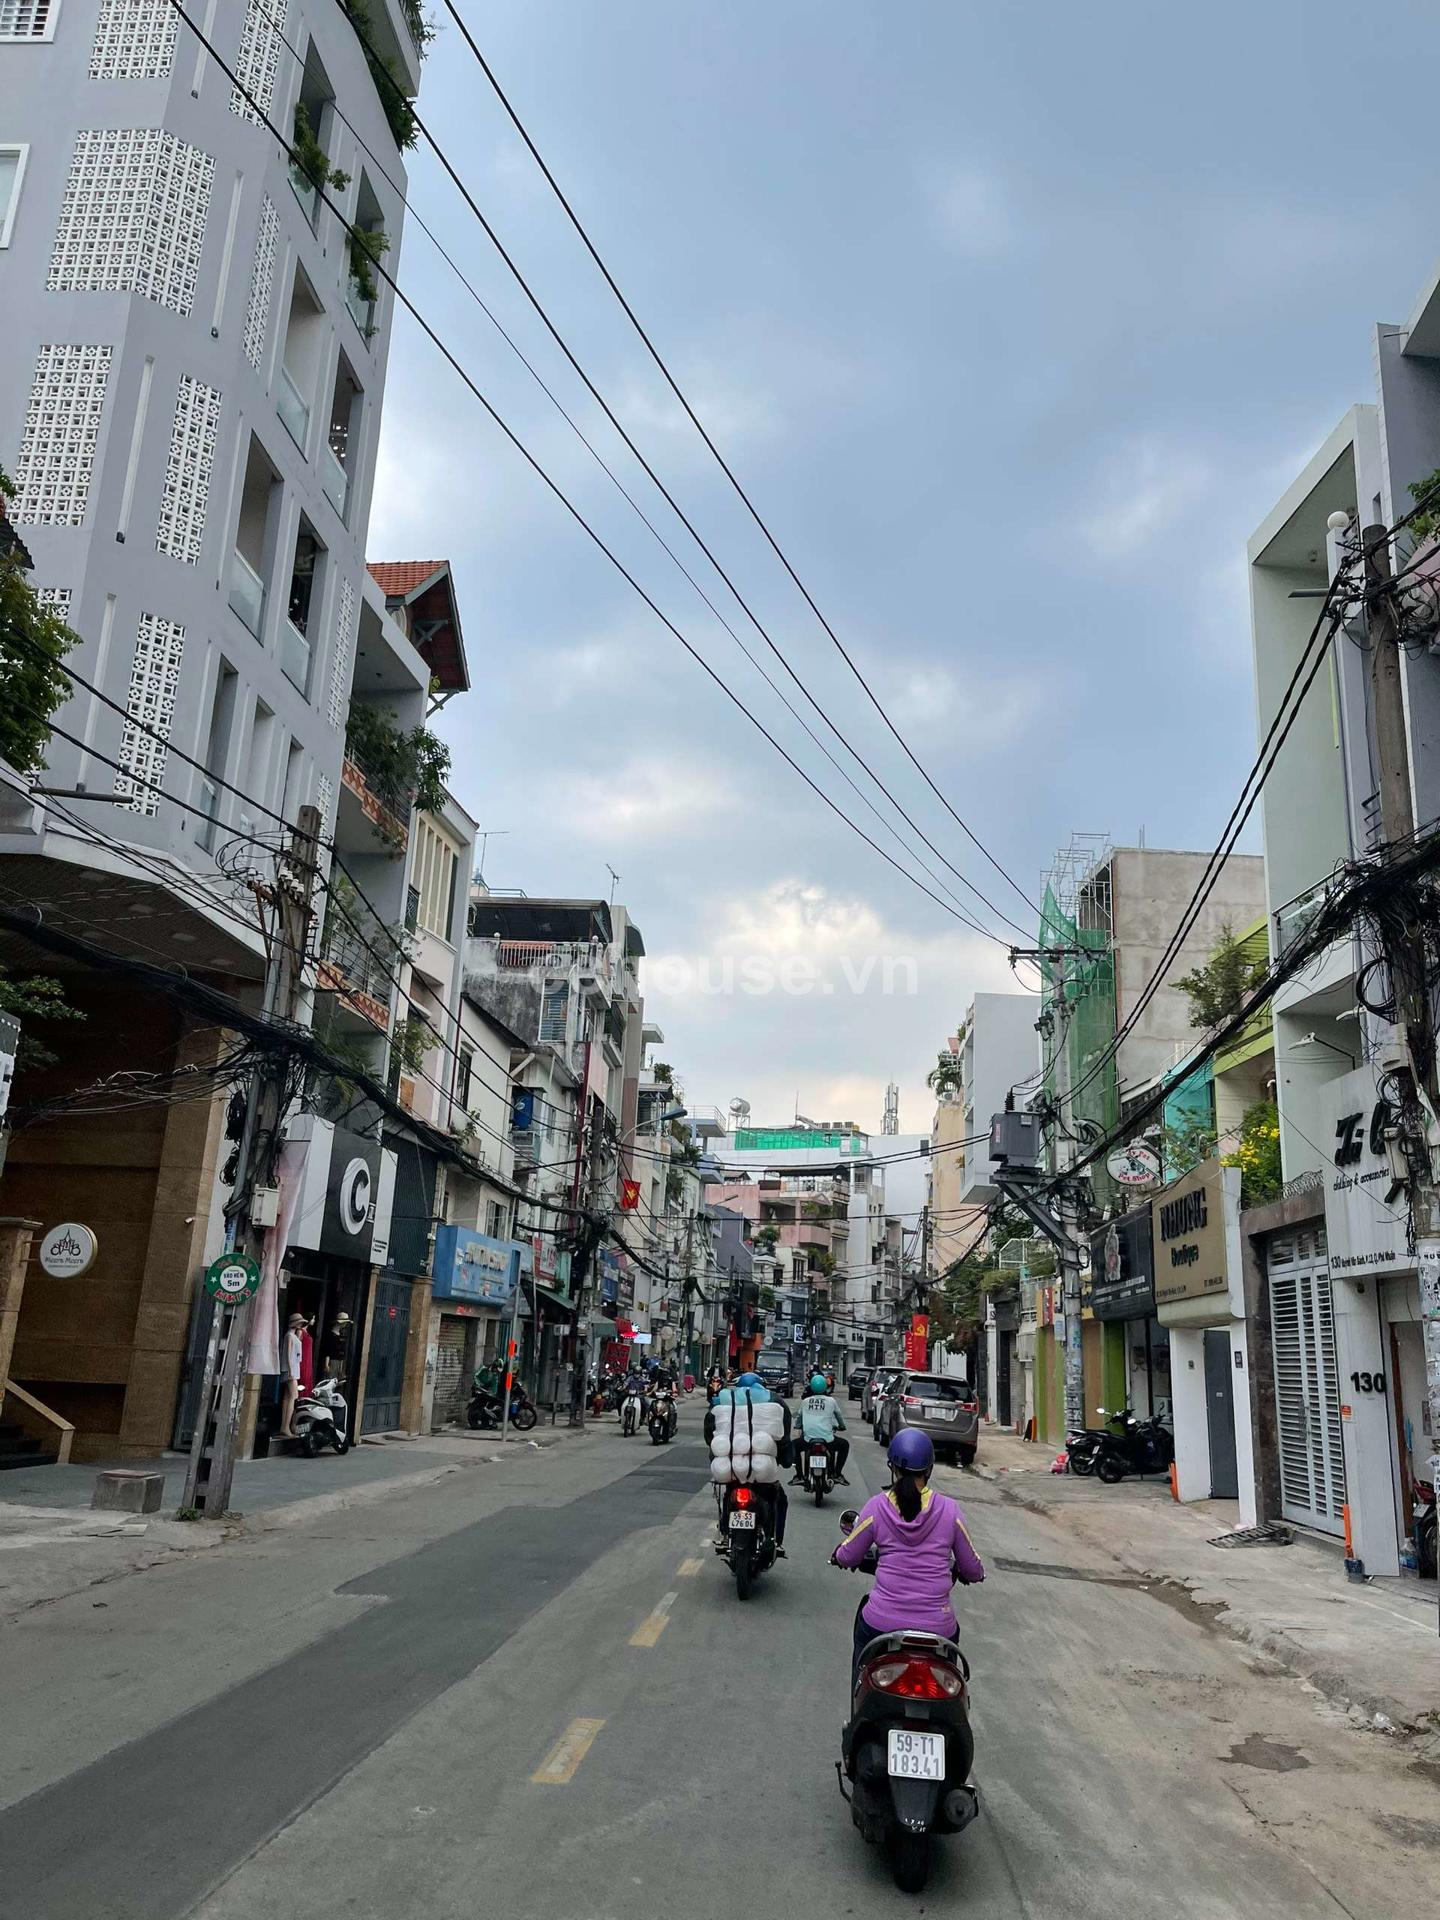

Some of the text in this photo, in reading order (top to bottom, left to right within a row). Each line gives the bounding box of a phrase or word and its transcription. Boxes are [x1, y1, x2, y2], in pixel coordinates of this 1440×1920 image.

[1351, 1372, 1386, 1393] 130
[896, 1734, 935, 1756] 59-T1
[891, 1753, 940, 1778] 183.41
